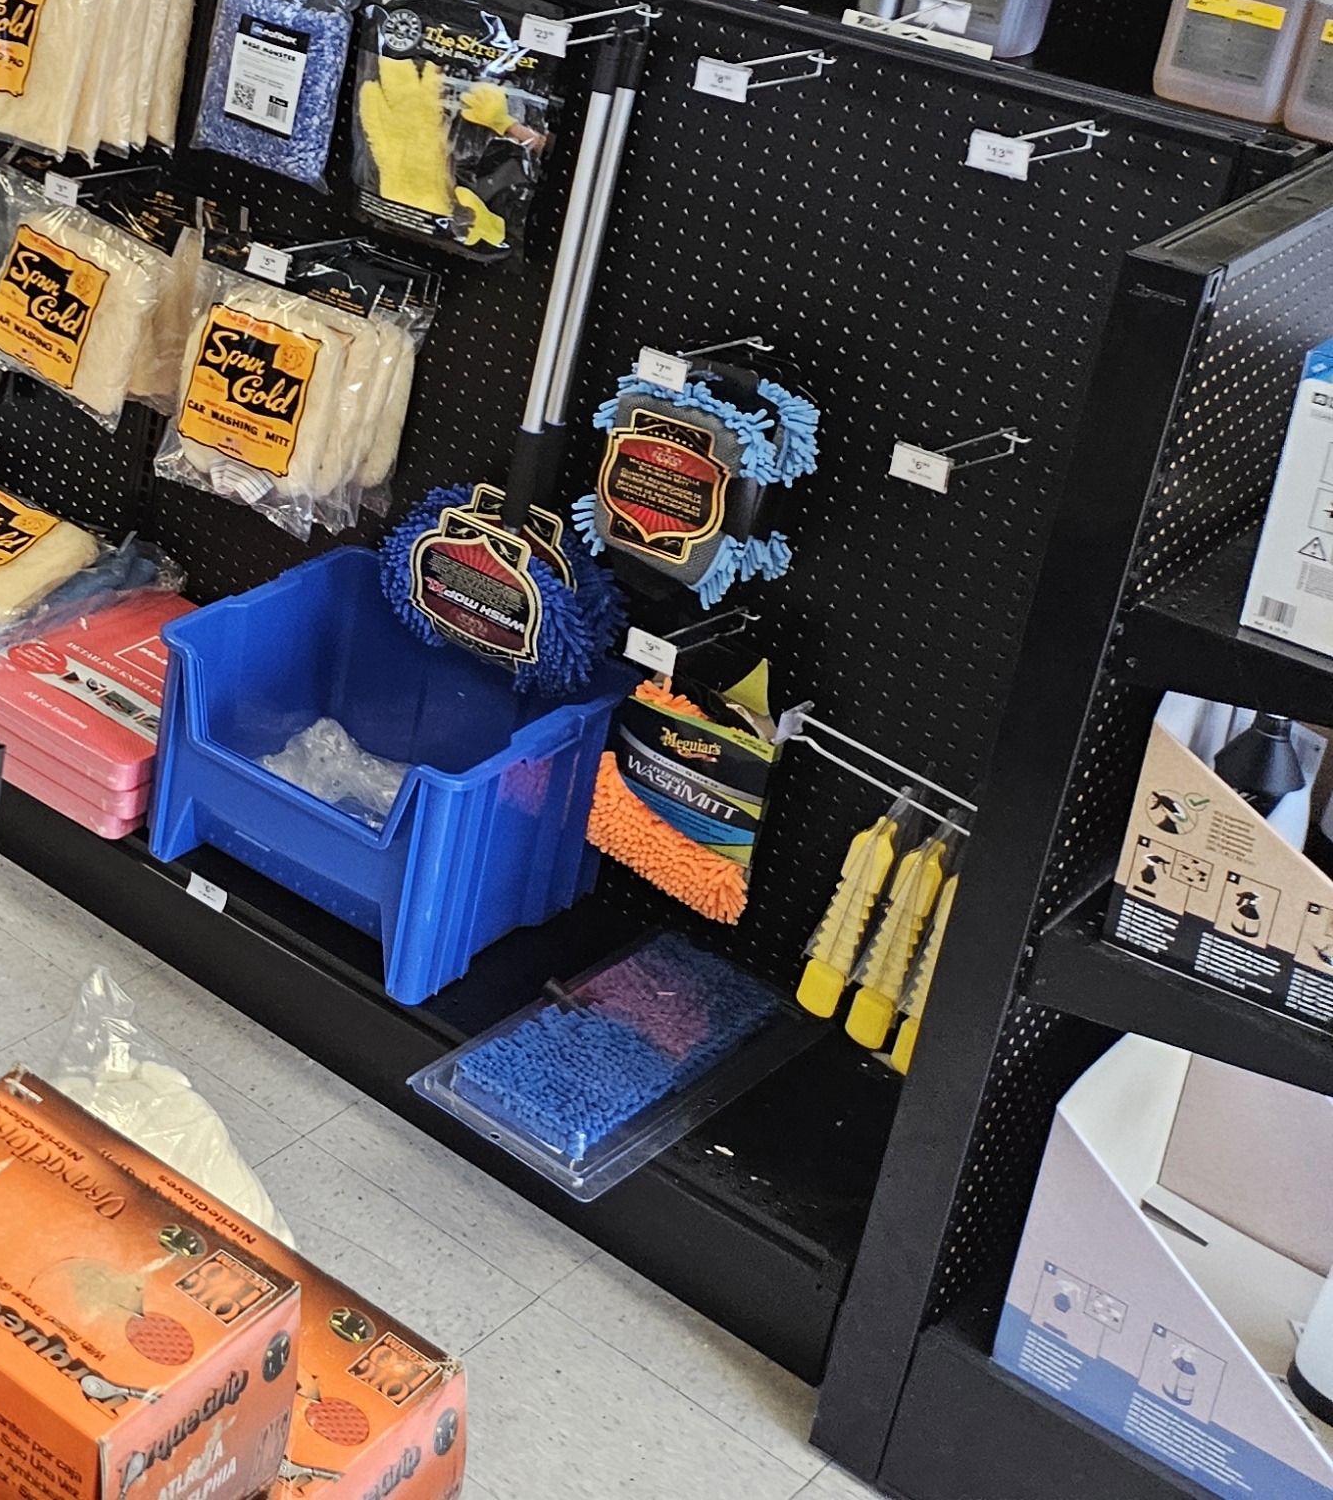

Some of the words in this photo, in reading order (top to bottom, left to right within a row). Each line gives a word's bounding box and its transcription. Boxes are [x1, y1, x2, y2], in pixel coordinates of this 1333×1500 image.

[7, 56, 25, 68] PAD
[262, 47, 297, 62] MONSTER
[425, 25, 455, 47] The
[456, 34, 539, 73] Straer
[9, 251, 62, 297] Spun
[30, 295, 86, 335] Gold
[13, 323, 54, 352] WASHING
[56, 347, 73, 365] PAD
[204, 330, 266, 375] Spun
[231, 375, 300, 414] Gold
[187, 399, 206, 415] CAR
[210, 410, 259, 436] WASHING
[264, 430, 291, 448] MITT
[480, 603, 526, 633] WASH
[660, 726, 722, 756] Meguiar's
[158, 1172, 257, 1245] NitrileGloves
[28, 1455, 58, 1482] Una
[52, 1456, 86, 1486] caja
